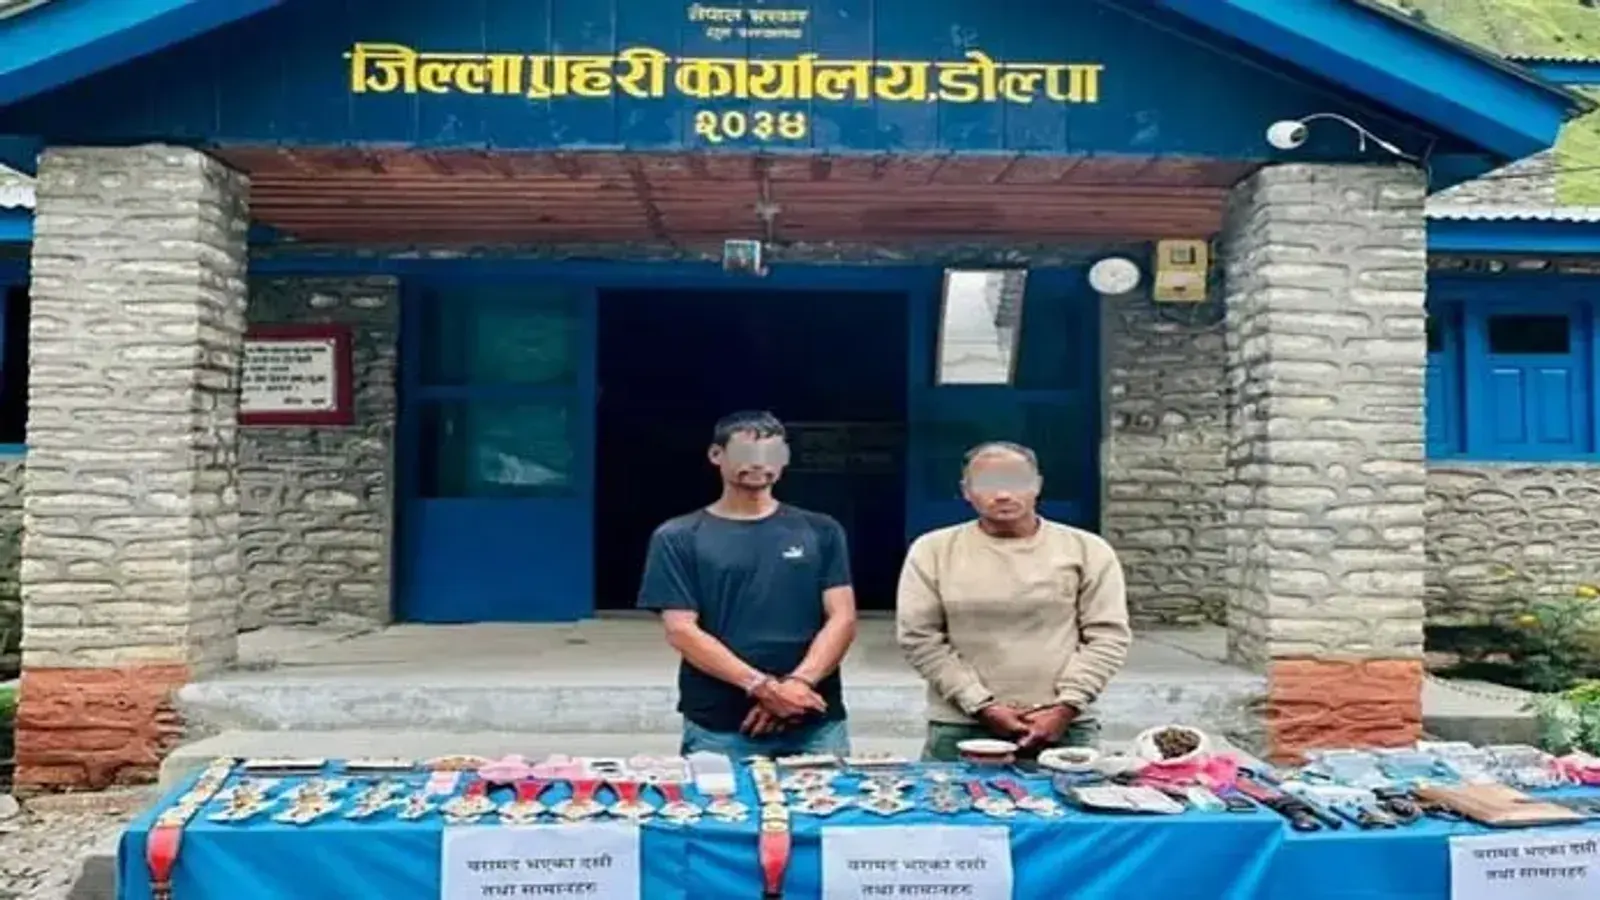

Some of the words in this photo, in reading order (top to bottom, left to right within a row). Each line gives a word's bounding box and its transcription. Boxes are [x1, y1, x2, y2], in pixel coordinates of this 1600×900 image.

[343, 43, 524, 93] जिल्ला
[526, 47, 670, 98] प्रहरी
[935, 50, 1104, 103] डोल्पा
[695, 110, 807, 142] २०३४
